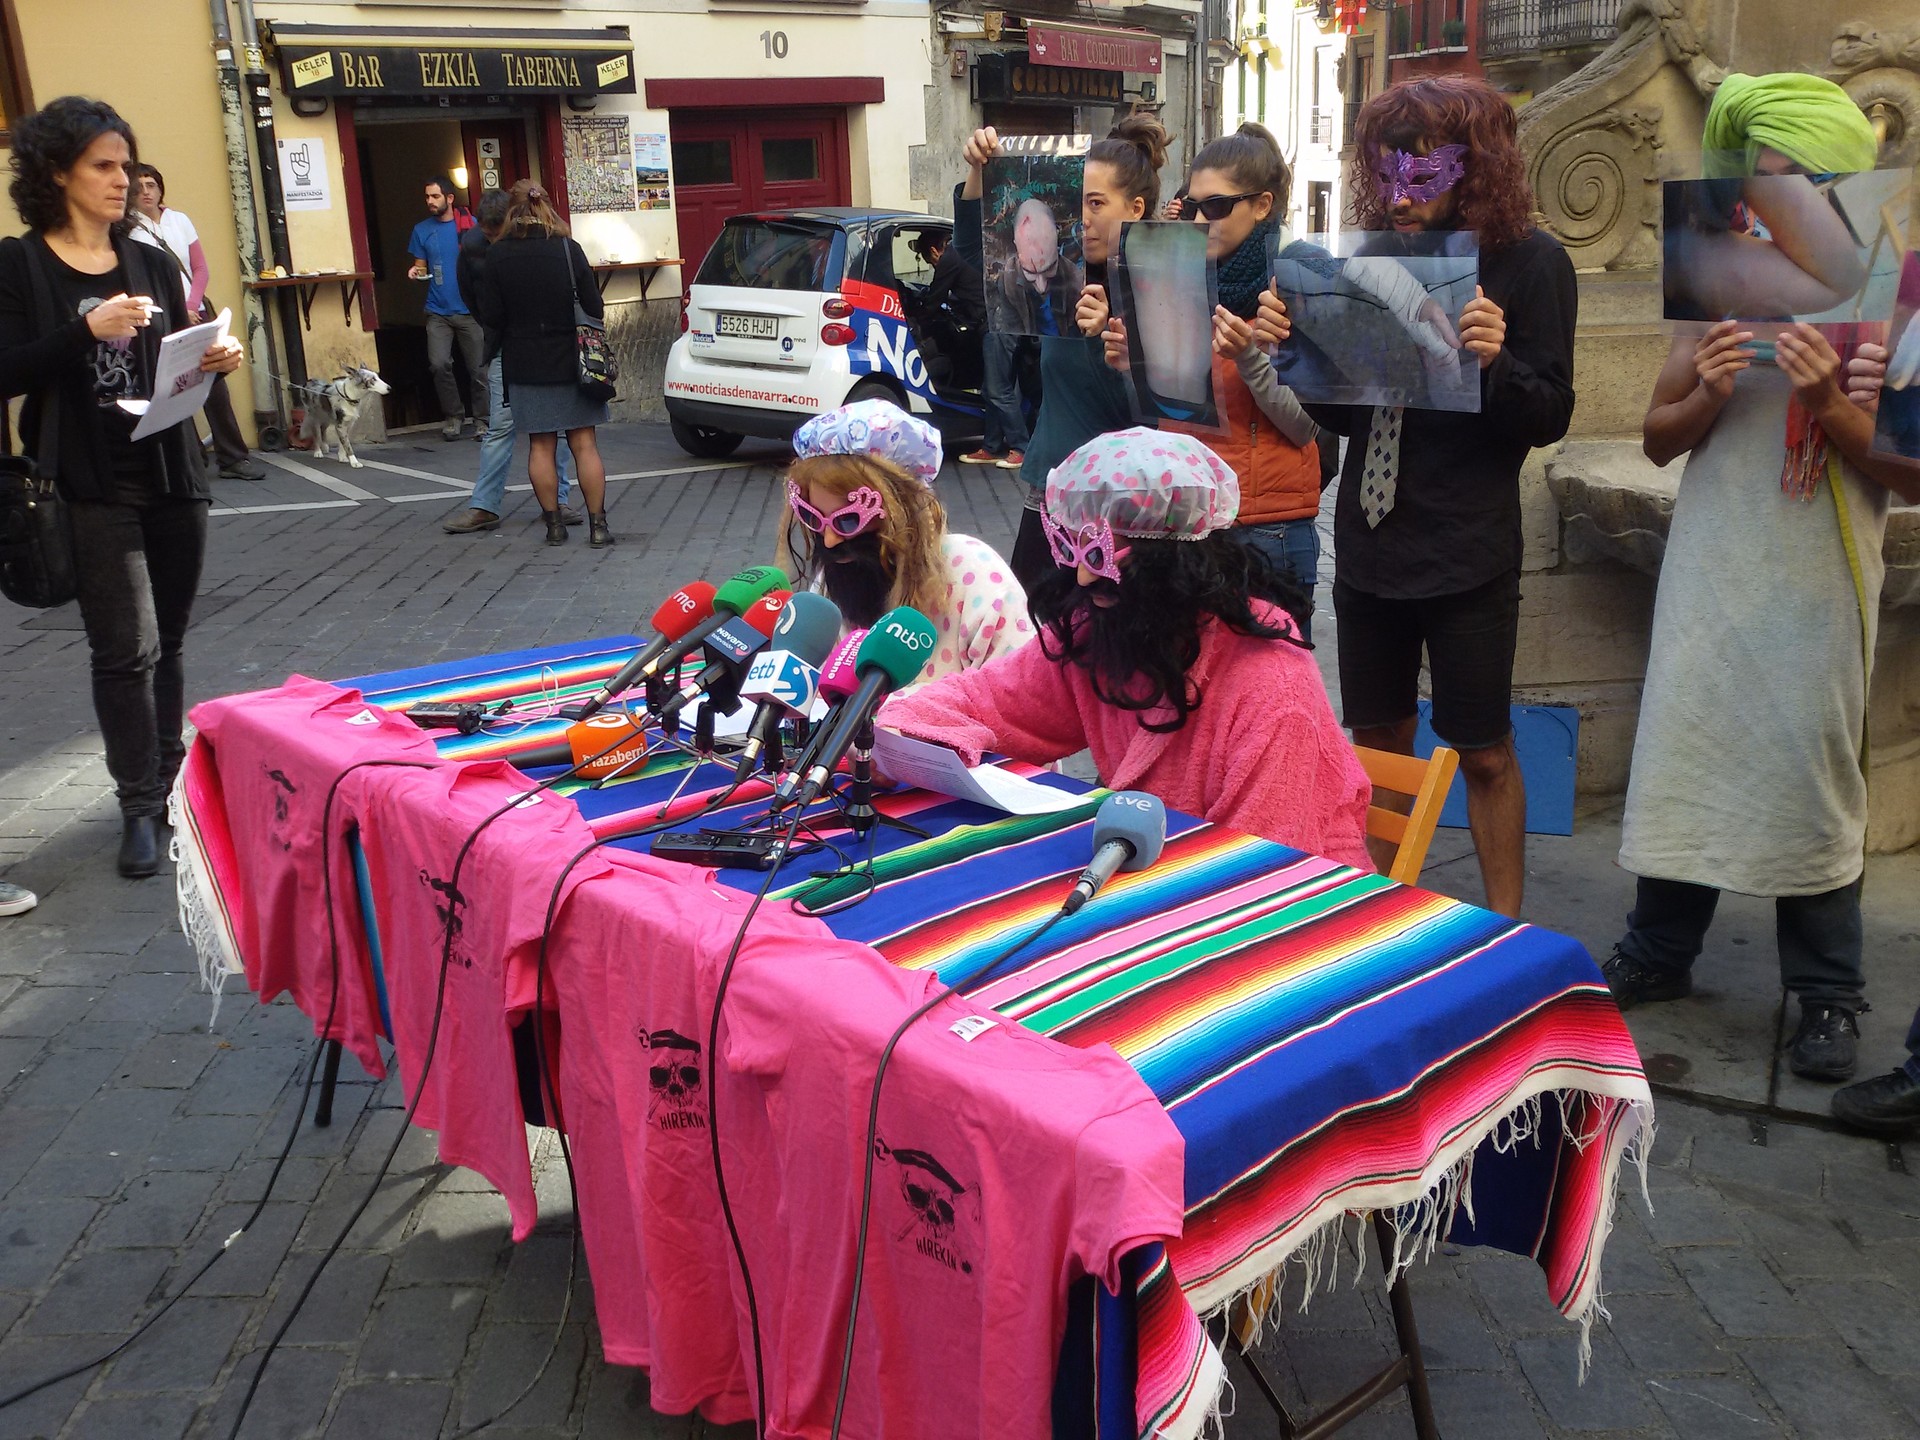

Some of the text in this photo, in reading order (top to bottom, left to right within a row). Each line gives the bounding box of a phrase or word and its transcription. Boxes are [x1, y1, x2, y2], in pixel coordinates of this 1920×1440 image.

[760, 31, 788, 58] 10
[1059, 35, 1138, 68] BAR CORDOVILLA
[296, 56, 329, 74] KELER
[340, 52, 581, 87] BAR EZKIA TABERNA
[600, 59, 625, 74] KELER
[1012, 66, 1119, 99] CORDOVILLA
[722, 316, 773, 335] 5526 HJH
[667, 380, 819, 407] www.noticiasdenavarra.com
[673, 591, 696, 613] rne
[748, 658, 776, 680] etb
[1114, 795, 1152, 812] tve
[660, 1111, 706, 1130] HIREKIN
[916, 1236, 957, 1272] HIREKIN
